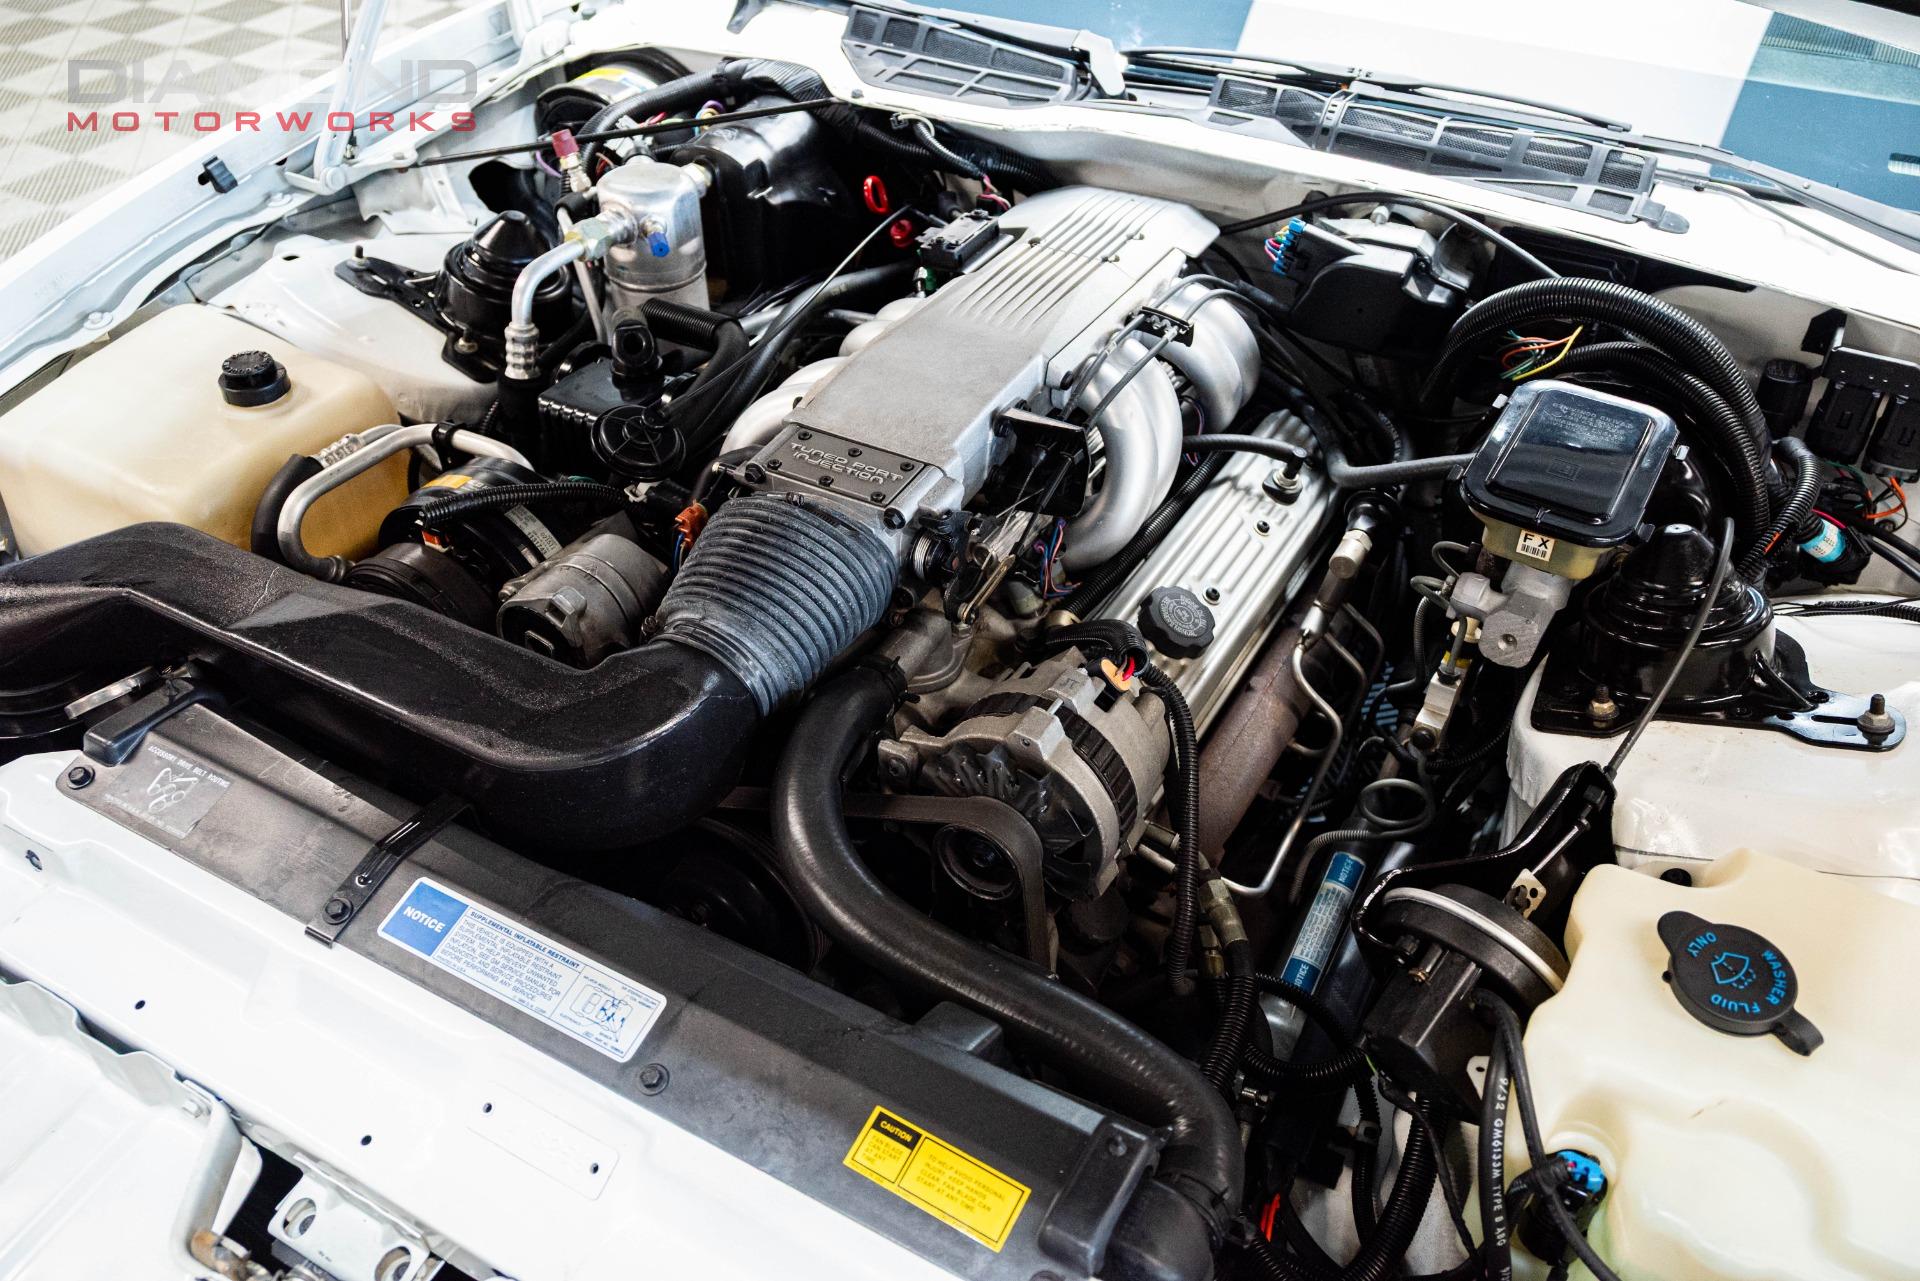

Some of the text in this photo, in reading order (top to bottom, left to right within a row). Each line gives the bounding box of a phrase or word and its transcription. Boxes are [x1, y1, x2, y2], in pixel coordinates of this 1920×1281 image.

[791, 442, 904, 481] TUNED PORT
[793, 451, 884, 485] INJECTION
[148, 745, 178, 764] ACCESSORY
[192, 766, 208, 777] BELT
[1338, 858, 1354, 882] NOTICE
[403, 906, 445, 933] NOTICE
[458, 925, 562, 981] SUPPLEMENTAL INFLATABLE RESTRAINT
[462, 919, 475, 928] THIS
[474, 925, 498, 940] VEHICLE
[505, 941, 533, 958] EQUIPPED
[533, 955, 549, 966] WITH
[470, 911, 579, 968] SUPPLEMENTAL INFLATABLE RESTRAINT
[444, 942, 553, 1001] DIAGNOSTIC AND SERVICE PROCEDURES
[476, 942, 485, 950] TO
[484, 946, 500, 957] HELP
[499, 954, 526, 971] PREVENT
[525, 967, 558, 987] UNWANTED
[477, 950, 490, 960] SEE
[489, 957, 501, 966] GM
[500, 962, 524, 978] SERVICE
[523, 974, 548, 990] MANUAL
[547, 987, 561, 997] FOR
[1687, 931, 1787, 1013] WASHER FLUID ONLY
[498, 978, 511, 988] ANY
[1494, 1077, 1509, 1110] 9/32
[880, 1120, 913, 1143] CAUTION
[1493, 1185, 1503, 1210] TYPE
